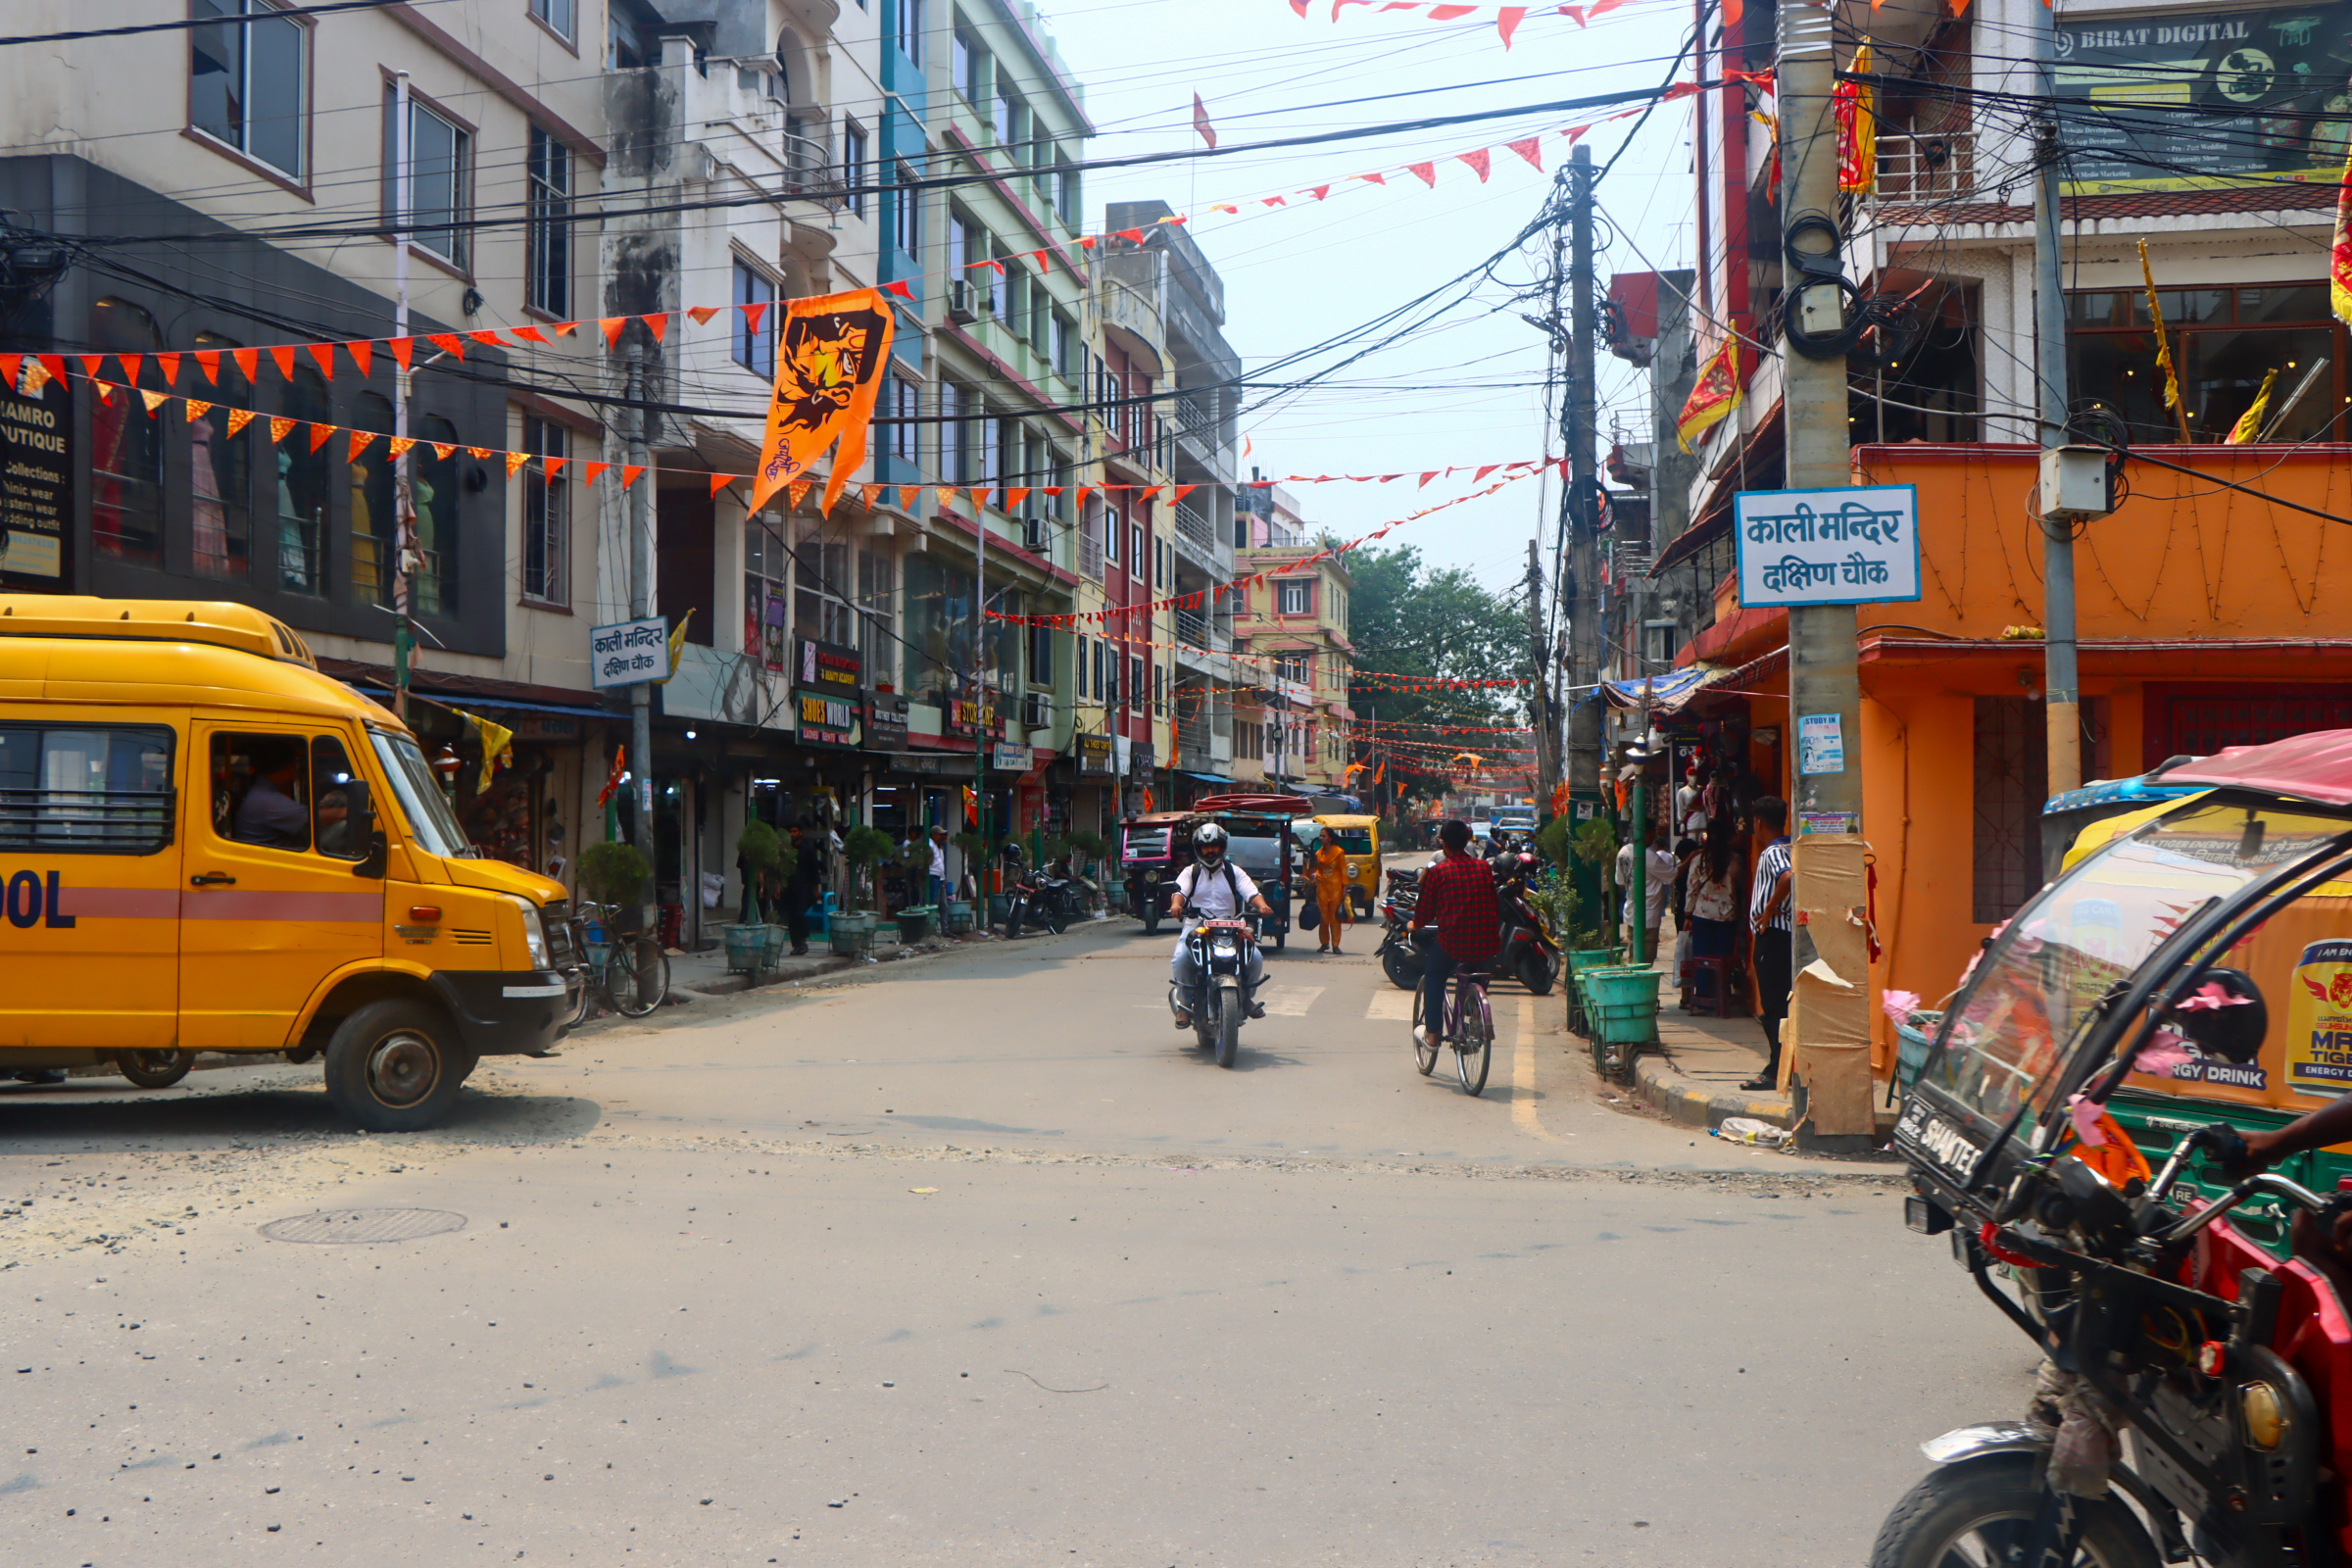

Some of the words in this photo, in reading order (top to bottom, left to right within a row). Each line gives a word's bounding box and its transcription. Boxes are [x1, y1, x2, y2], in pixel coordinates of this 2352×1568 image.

[2081, 28, 2150, 48] BIRAT
[2157, 22, 2249, 44] DIGITAL
[2100, 170, 2131, 178] Marketing
[0, 424, 67, 455] UTIQUE
[30, 487, 54, 501] wear
[35, 503, 58, 516] wear
[1746, 503, 1817, 544] काली
[1819, 502, 1904, 545] मन्दिर
[1763, 555, 1837, 593] दक्षिण
[1840, 552, 1888, 585] चौक
[595, 630, 622, 654] काली
[624, 626, 663, 647] मन्दिर
[603, 657, 629, 677] दक्षिण
[631, 654, 654, 670] चौक
[802, 696, 825, 723] SHOES
[826, 701, 850, 727] WORLD
[962, 702, 978, 724] STOR
[1805, 716, 1827, 725] STUDY
[2156, 839, 2191, 850] TIGER
[2190, 840, 2231, 850] ENERGY
[0, 870, 75, 928] OL
[2323, 948, 2337, 956] AM
[2173, 1063, 2203, 1079] RGY
[2207, 1066, 2263, 1087] DRINK
[2305, 1065, 2344, 1078] ENERGY
[2176, 1189, 2192, 1203] RE
